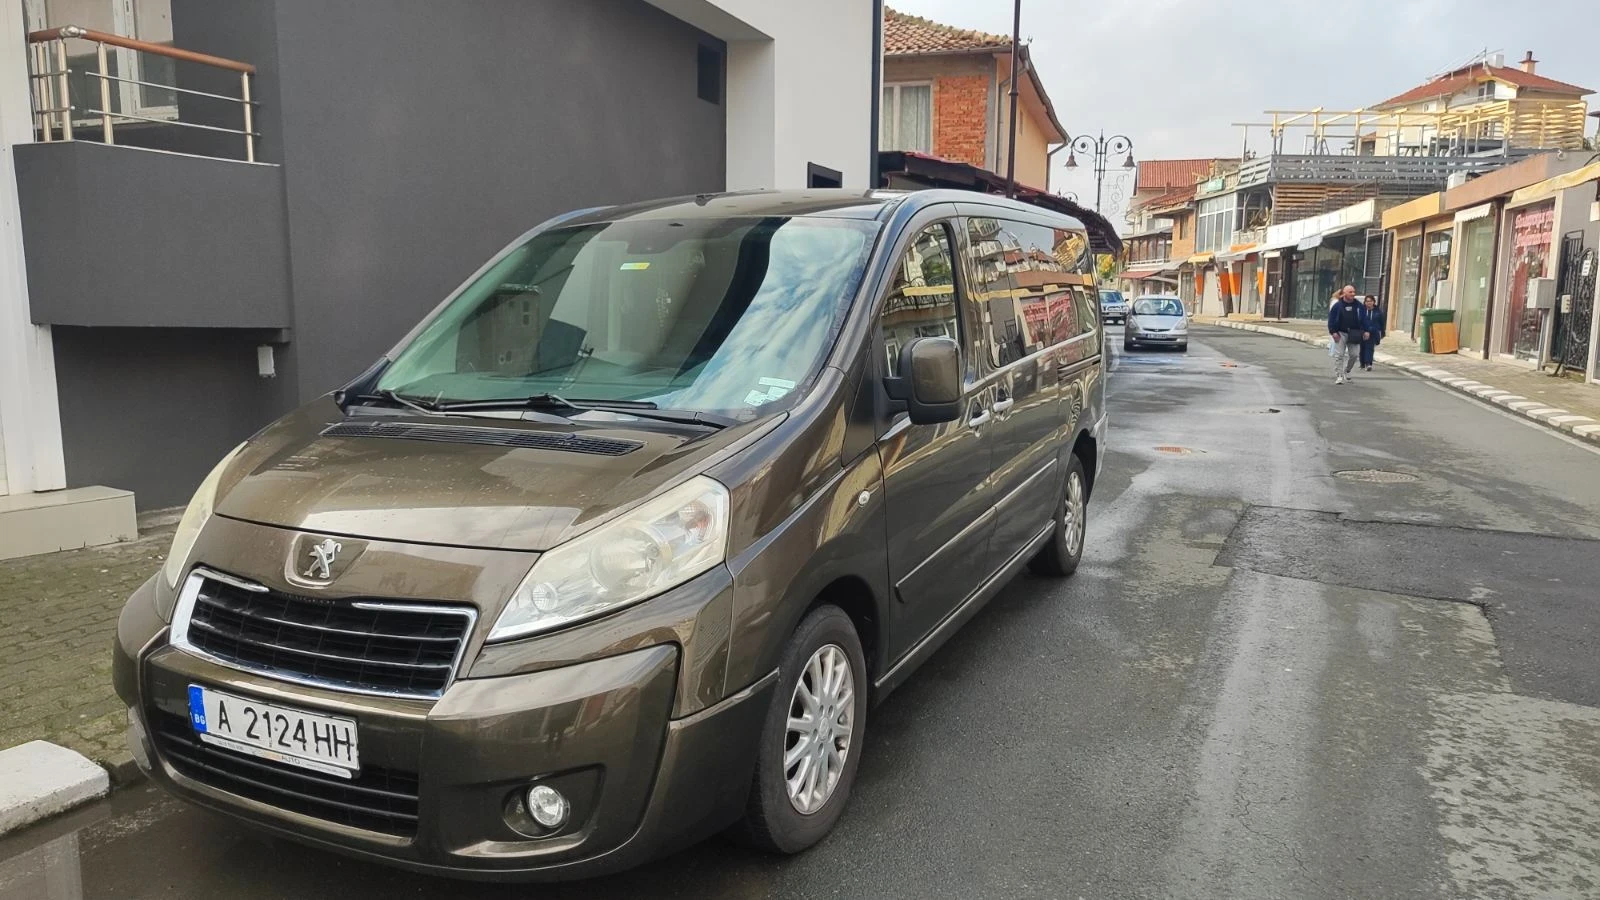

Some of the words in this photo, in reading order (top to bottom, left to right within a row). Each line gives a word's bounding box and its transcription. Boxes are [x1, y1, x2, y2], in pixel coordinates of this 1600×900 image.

[194, 713, 206, 725] BG
[218, 700, 232, 733] A
[243, 706, 307, 752] 2124
